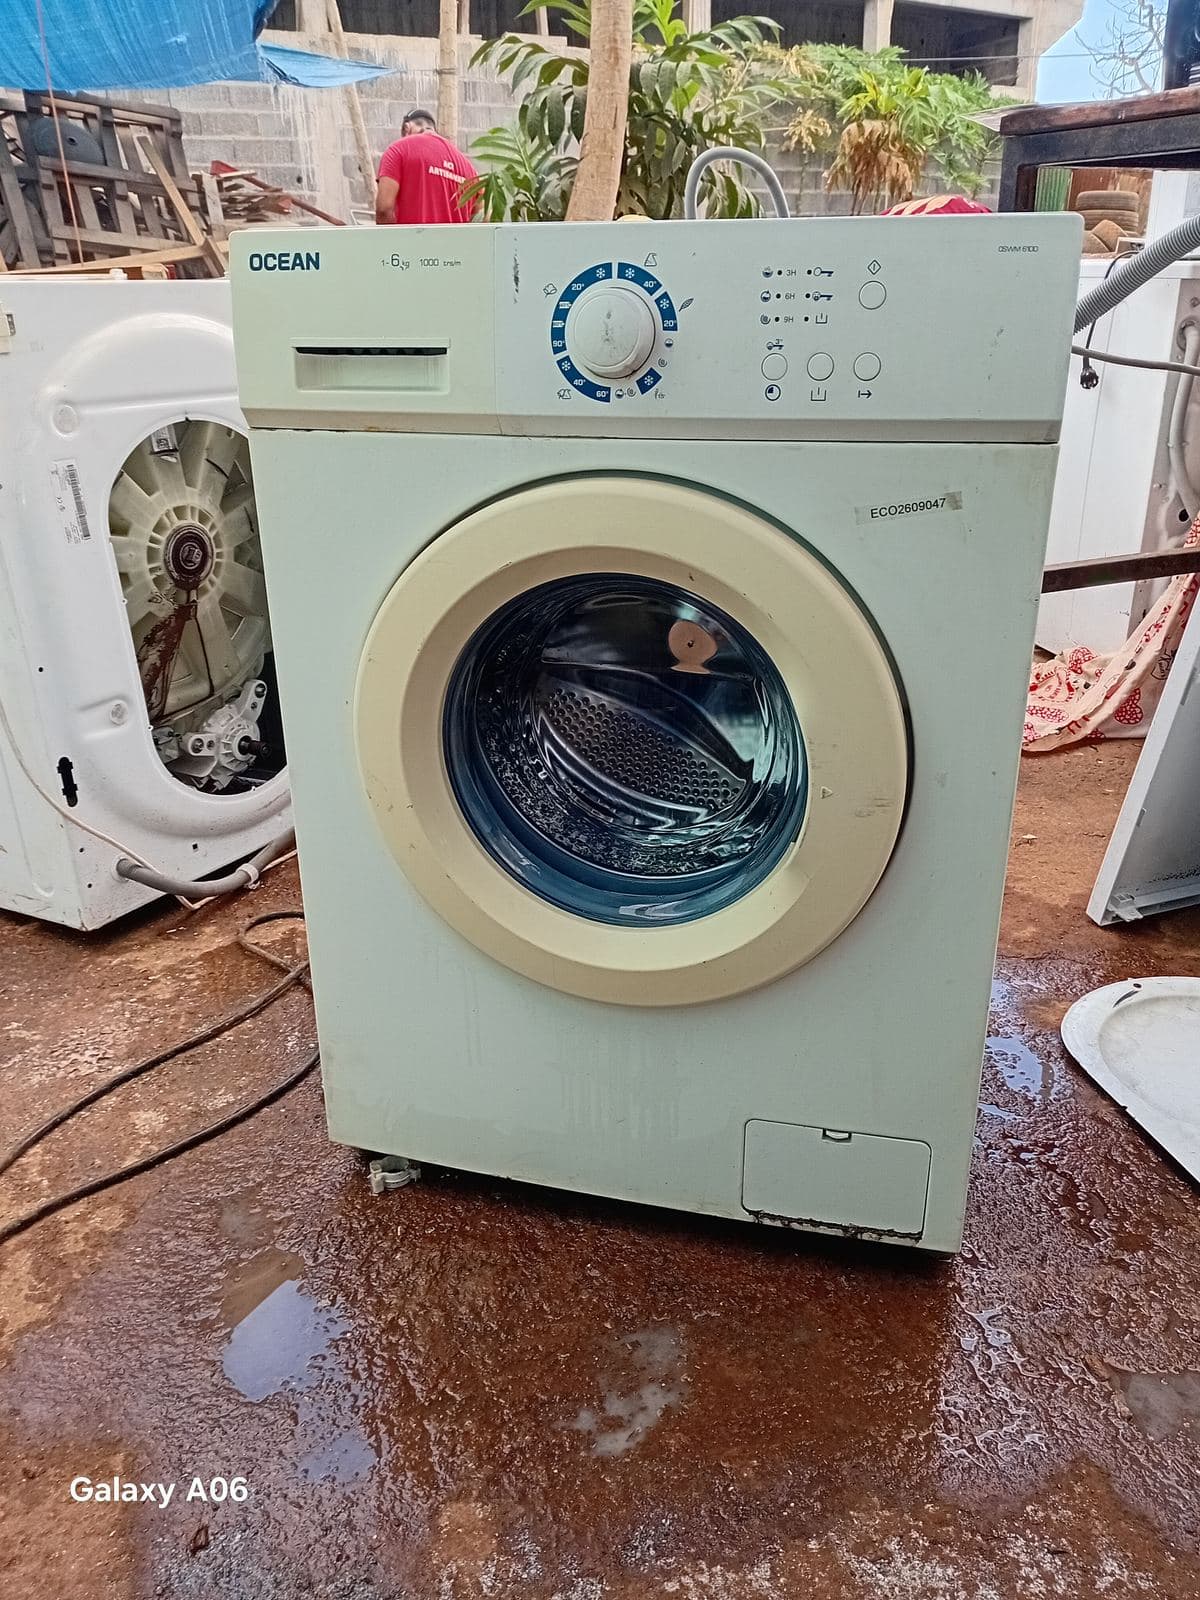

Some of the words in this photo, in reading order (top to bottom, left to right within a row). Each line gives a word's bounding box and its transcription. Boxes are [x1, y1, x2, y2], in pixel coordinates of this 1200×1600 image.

[249, 252, 320, 271] OCEAN
[420, 258, 440, 267] 1000
[571, 283, 585, 291] 20°
[643, 280, 657, 288] 40°
[552, 340, 565, 348] 90°
[596, 390, 609, 398] 60°
[870, 498, 946, 519] ECO2609047
